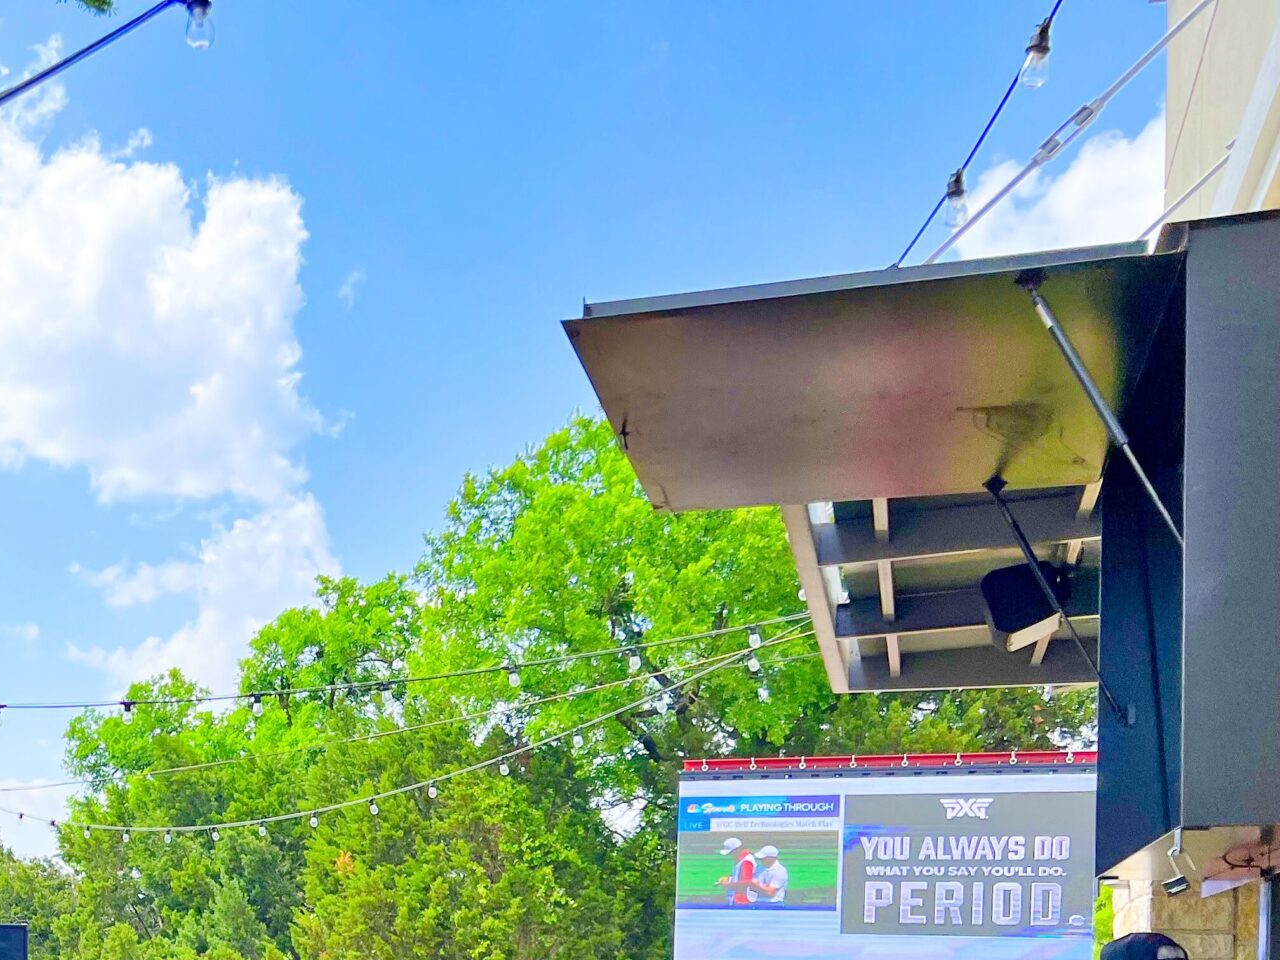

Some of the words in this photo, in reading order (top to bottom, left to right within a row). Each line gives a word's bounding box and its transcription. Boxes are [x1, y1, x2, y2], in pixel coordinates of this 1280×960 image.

[740, 803, 782, 812] PLAYING
[783, 802, 834, 812] THROUGH
[860, 836, 910, 860] YOU
[918, 836, 1026, 860] ALWAYS
[1034, 836, 1070, 860] DO
[865, 866, 910, 876] WHAT
[912, 866, 944, 876] YOU
[947, 866, 979, 876] SAY
[981, 866, 1035, 877] YOU'LL
[1038, 866, 1067, 877] DO.
